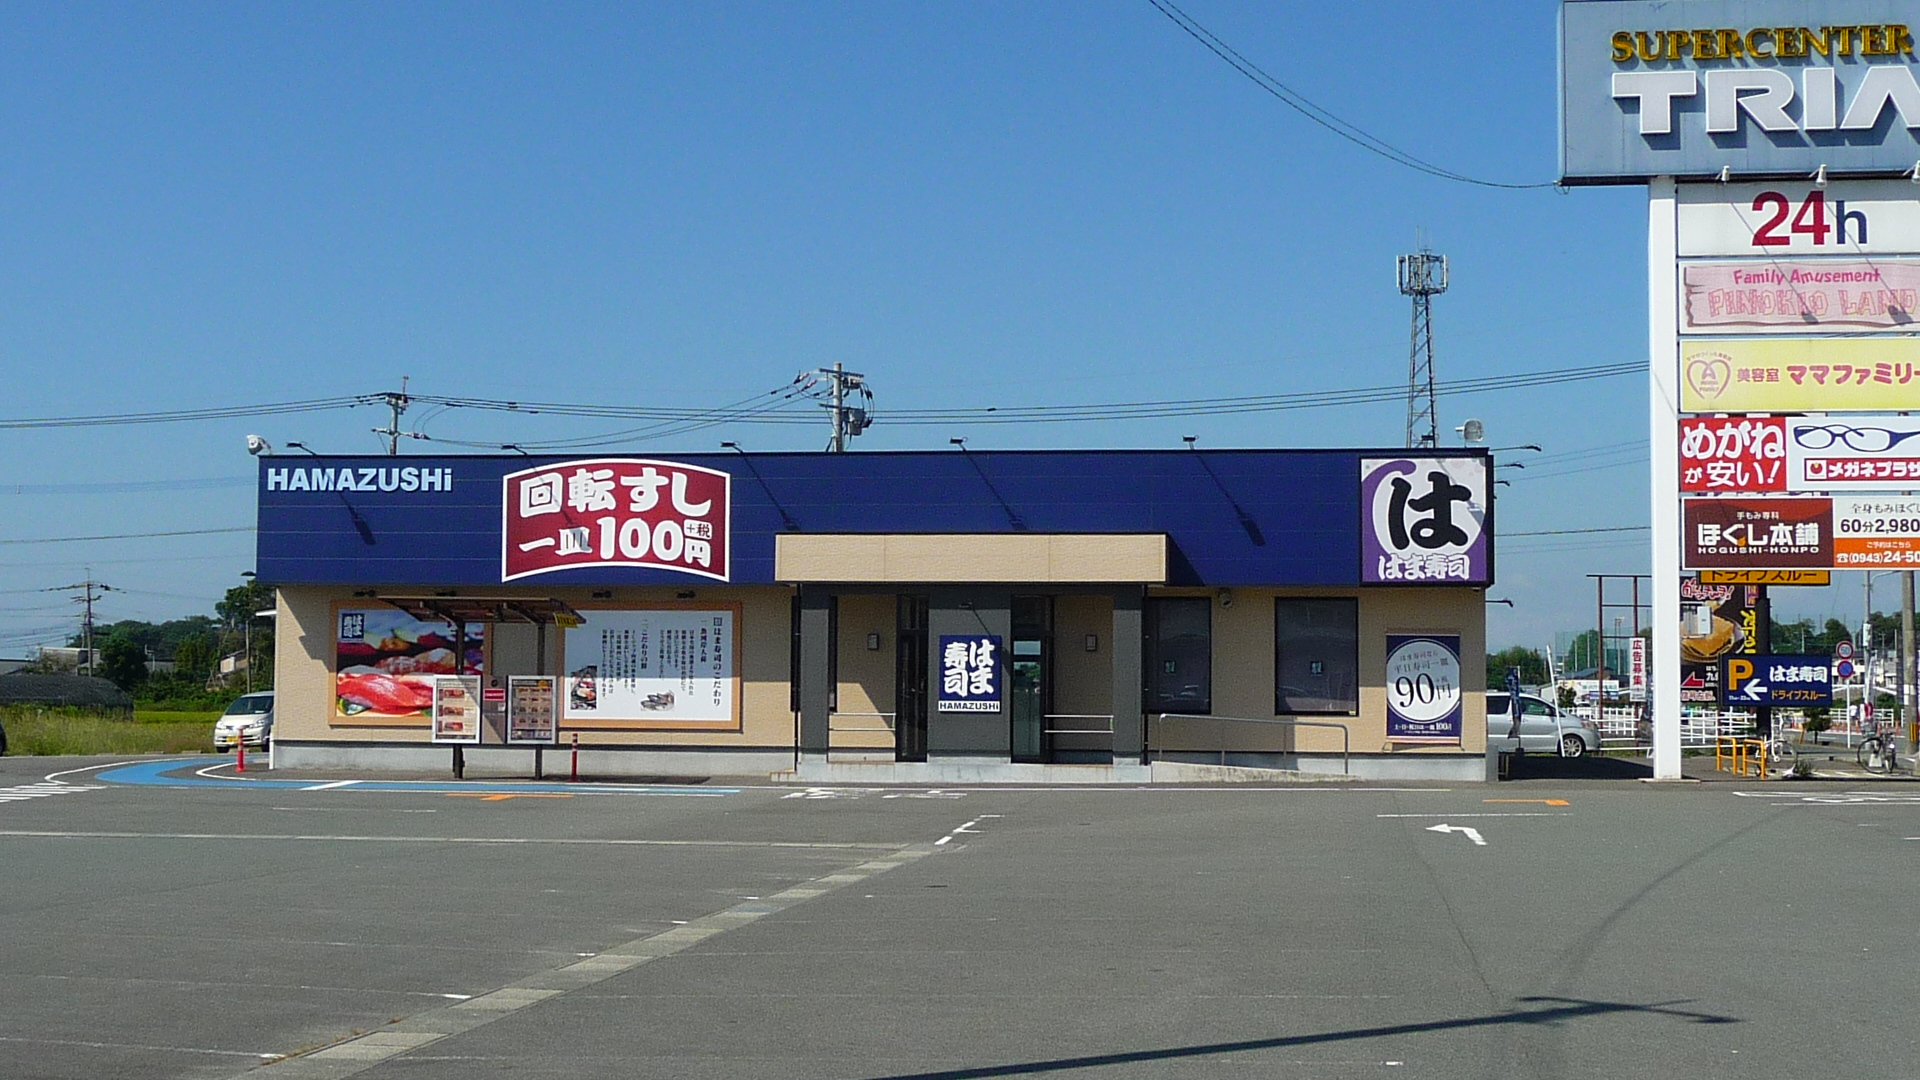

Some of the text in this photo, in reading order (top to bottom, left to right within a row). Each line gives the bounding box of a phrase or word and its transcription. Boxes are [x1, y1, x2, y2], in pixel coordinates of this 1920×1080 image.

[1611, 24, 1913, 62] SUPERCENTER
[1752, 190, 1868, 246] 24h
[1733, 268, 1880, 285] Family Amusement
[1708, 288, 1918, 317] PINOKIO LAND
[1737, 367, 1780, 383] 美容室
[1681, 420, 1786, 460] めがね
[267, 467, 452, 492] HAMAZUSHi
[1684, 460, 1780, 486] が安い!
[519, 467, 711, 518] 回転すし
[1388, 471, 1472, 550] は
[1697, 522, 1819, 546] ほぐし本舗
[1697, 546, 1820, 554] HOGUSHI-HONPO
[1378, 553, 1471, 580] はま寿司
[1632, 639, 1643, 686] 広告募集
[1729, 659, 1753, 690] P
[1769, 666, 1828, 683] はま寿司
[1771, 690, 1828, 700] ドライブスルー
